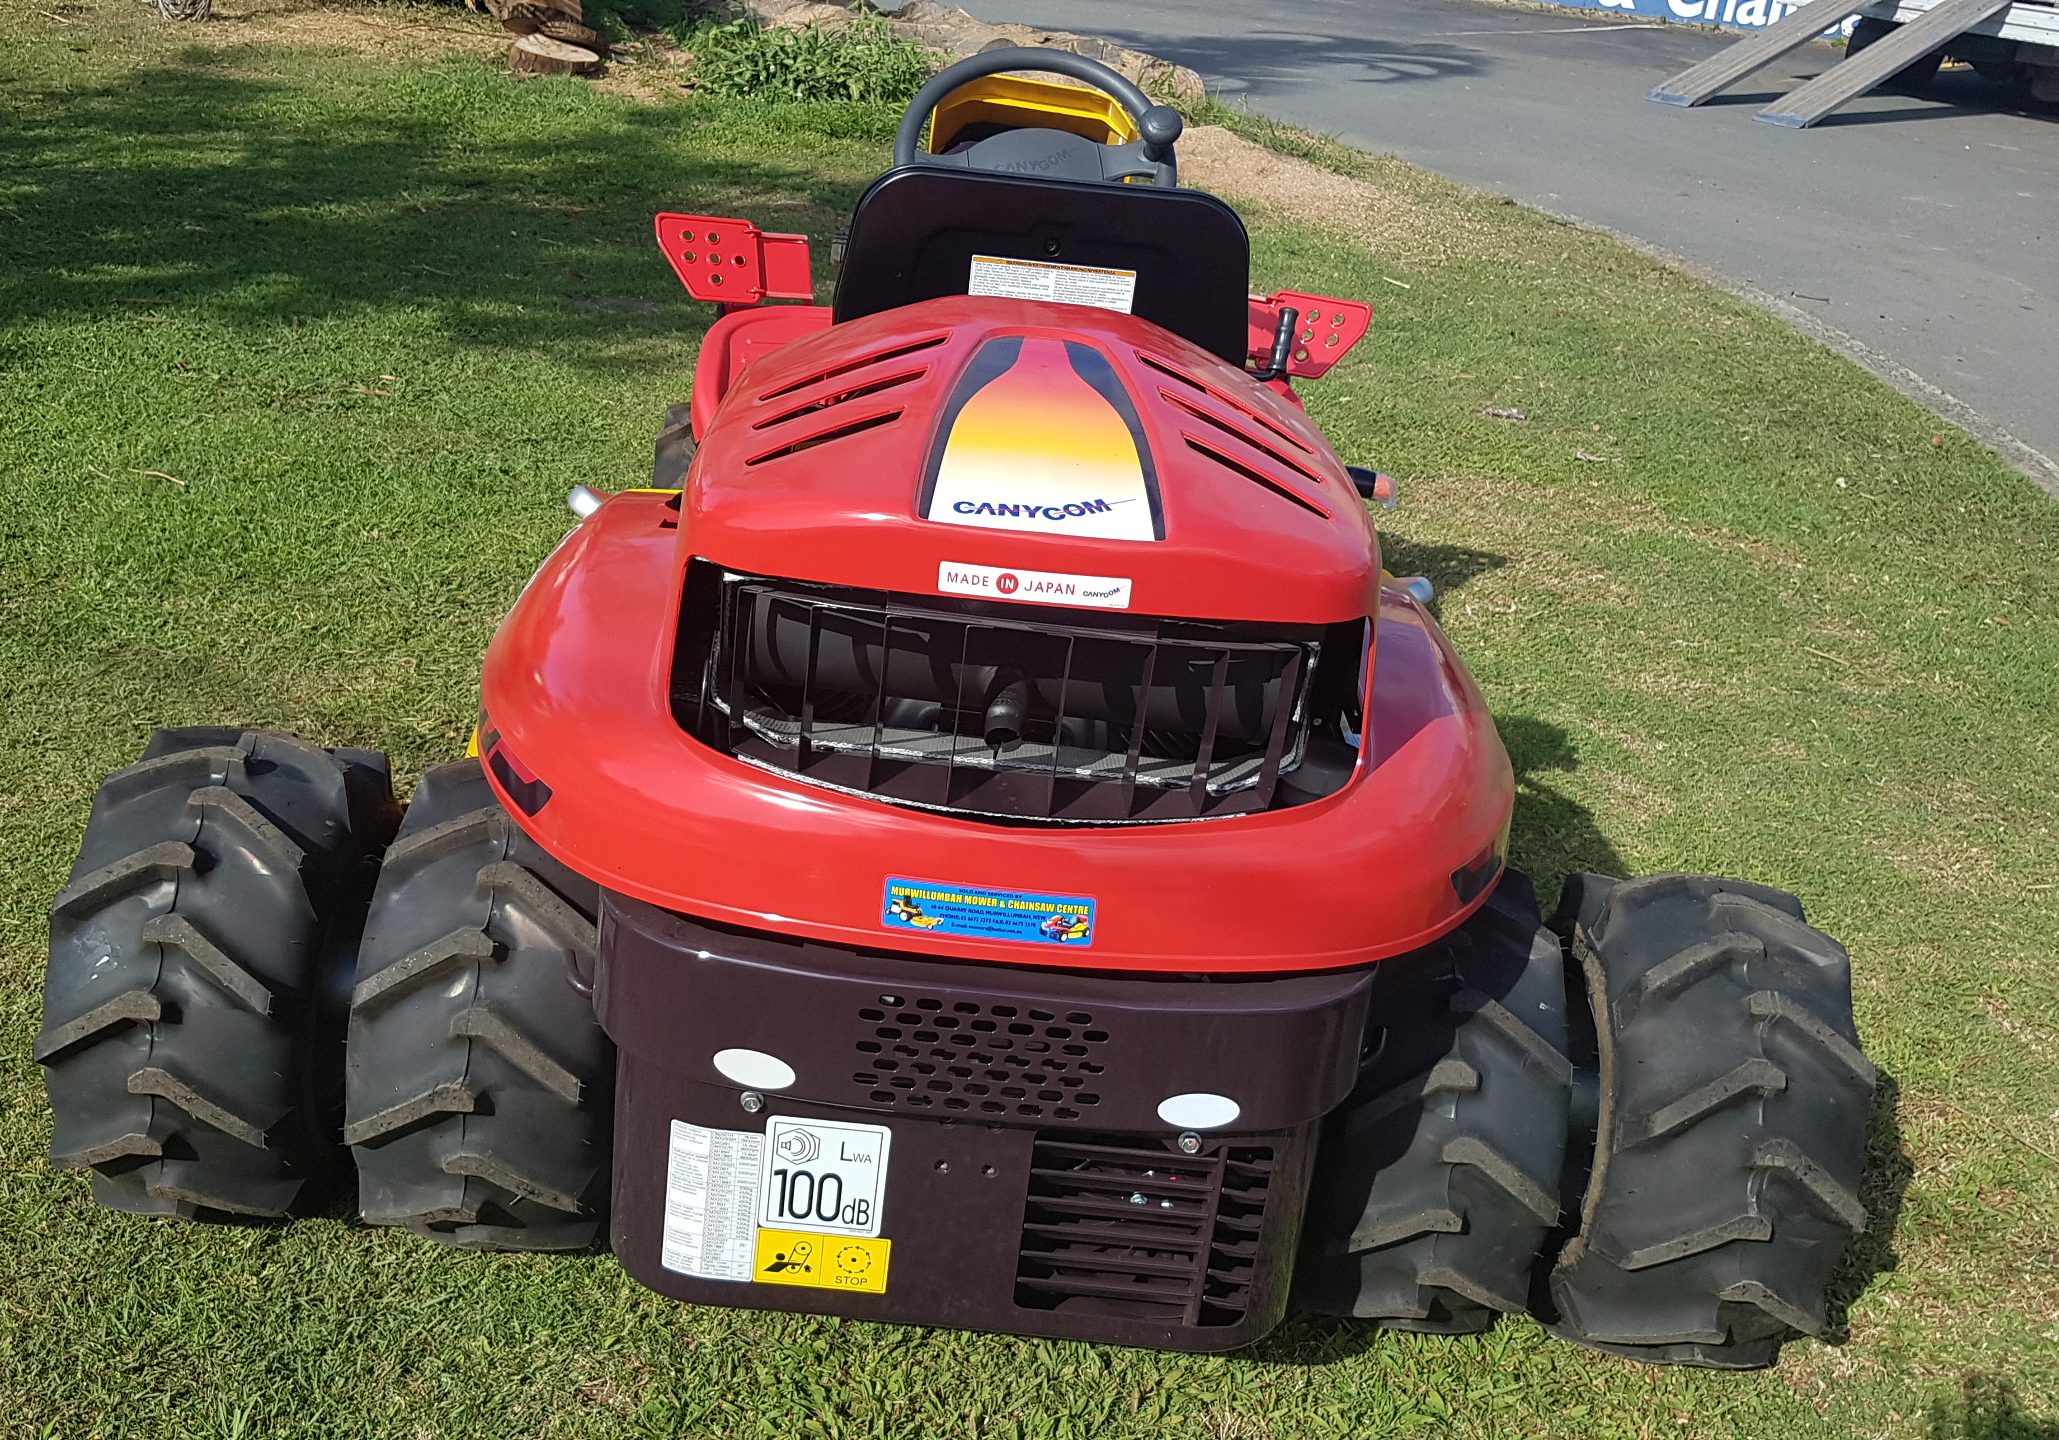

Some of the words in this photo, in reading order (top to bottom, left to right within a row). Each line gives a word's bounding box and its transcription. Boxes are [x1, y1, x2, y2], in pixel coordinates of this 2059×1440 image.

[995, 150, 1071, 172] CANYCOM
[953, 498, 1113, 521] CANYCOM
[947, 572, 990, 587] MADE
[1000, 577, 1015, 590] IN
[1024, 580, 1076, 595] JAPAN
[1082, 587, 1121, 598] CANYCOM
[890, 886, 963, 903] MURWILLUMBAH
[964, 895, 998, 907] MOWER
[999, 900, 1006, 908] &
[1007, 899, 1056, 913] CHAINSAW
[1056, 904, 1089, 915] CENTRE
[834, 1275, 868, 1286] STOP
